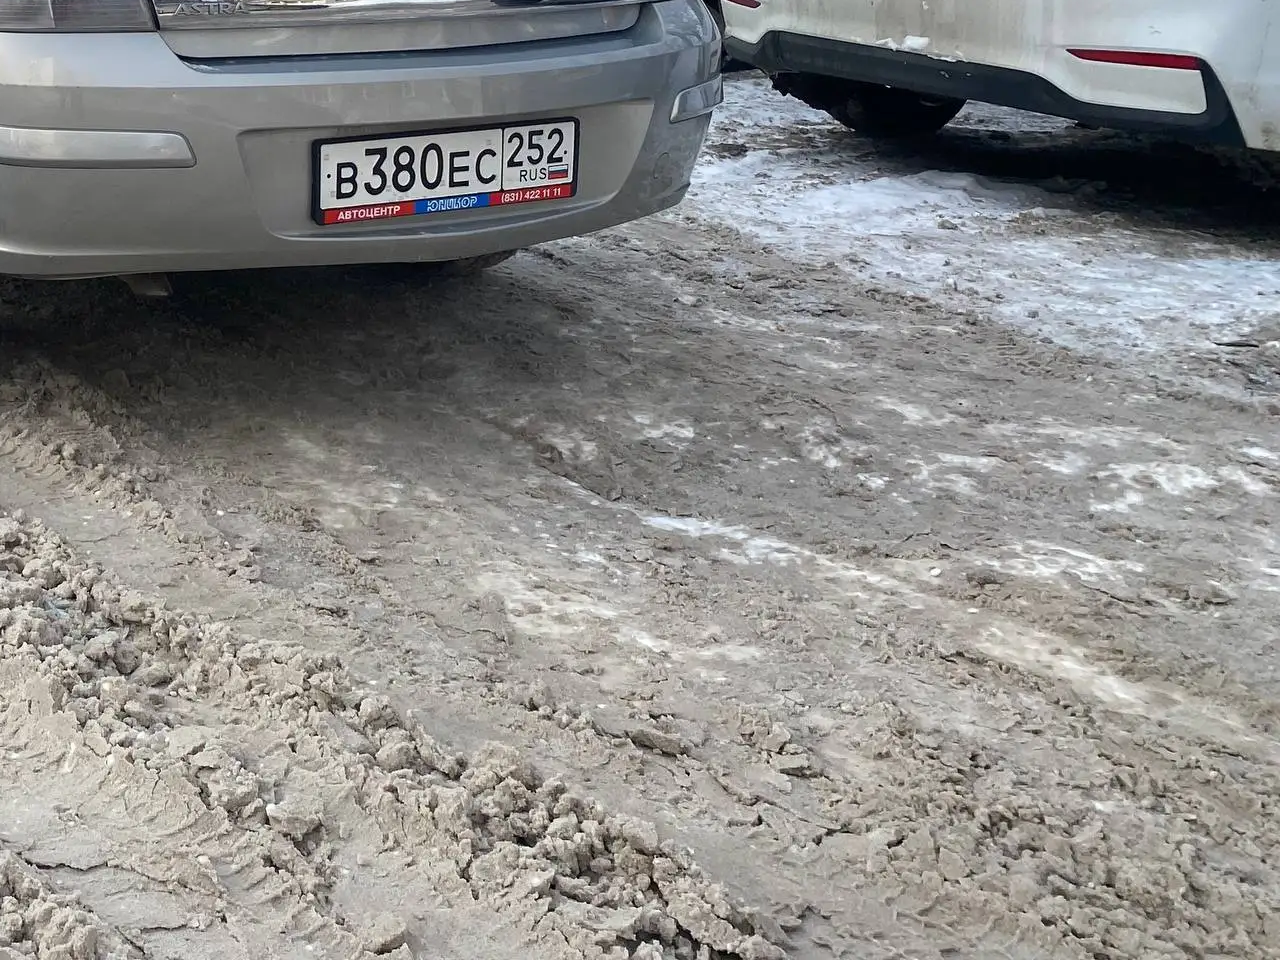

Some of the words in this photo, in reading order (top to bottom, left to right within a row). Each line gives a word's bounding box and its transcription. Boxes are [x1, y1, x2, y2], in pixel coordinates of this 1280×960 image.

[174, 1, 250, 16] ASTRA
[336, 143, 497, 200] В380ЕС
[506, 128, 564, 168] 252
[520, 167, 547, 182] RUS
[501, 191, 523, 203] (831)
[524, 190, 540, 200] 422
[337, 205, 401, 220] АВТОЦЕНТР
[427, 196, 478, 212] ЮНИКОР
